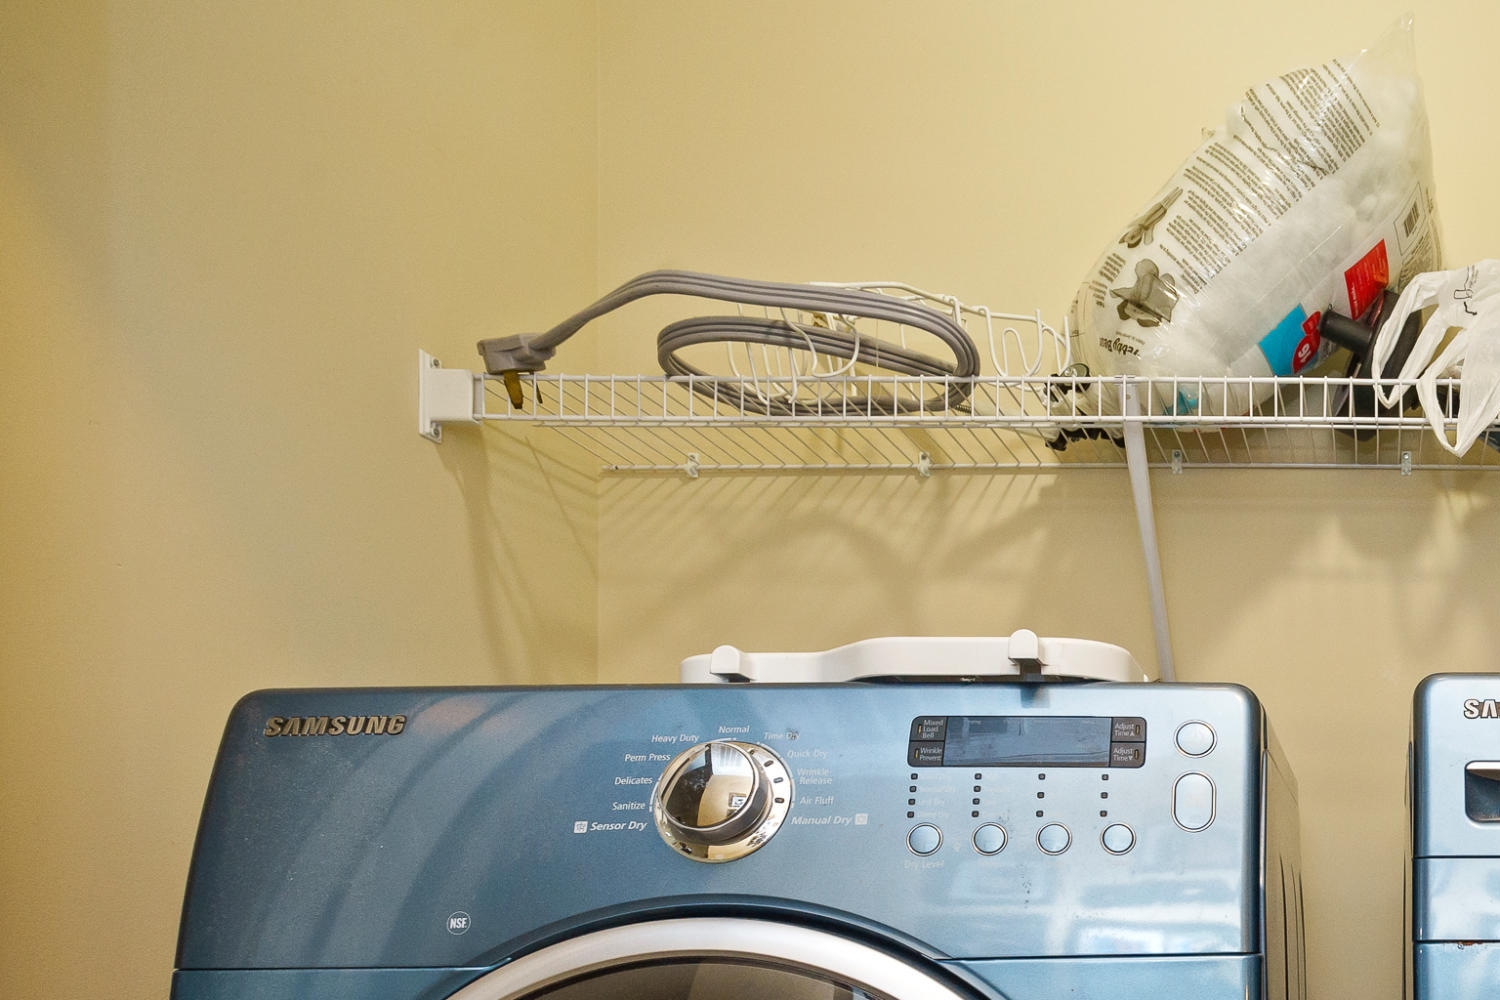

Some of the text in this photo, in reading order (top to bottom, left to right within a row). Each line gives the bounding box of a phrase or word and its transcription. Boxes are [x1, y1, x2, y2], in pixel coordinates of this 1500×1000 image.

[264, 714, 407, 736] SAMSUNG
[718, 725, 750, 734] Normal
[1115, 722, 1135, 731] Adjust
[652, 734, 700, 744] Heavy Duty
[787, 749, 828, 759] Quick Dry
[1113, 747, 1133, 756] Adjust
[625, 753, 671, 762] Perm Press
[797, 768, 830, 777] Wrinkle
[614, 776, 652, 785] Delicates
[799, 776, 832, 785] Release
[612, 801, 645, 811] Sanitize
[800, 796, 834, 806] Air Fluff
[791, 815, 854, 826] Manual Dry
[590, 821, 648, 832] Sensor Dry
[450, 918, 467, 929] NSF
